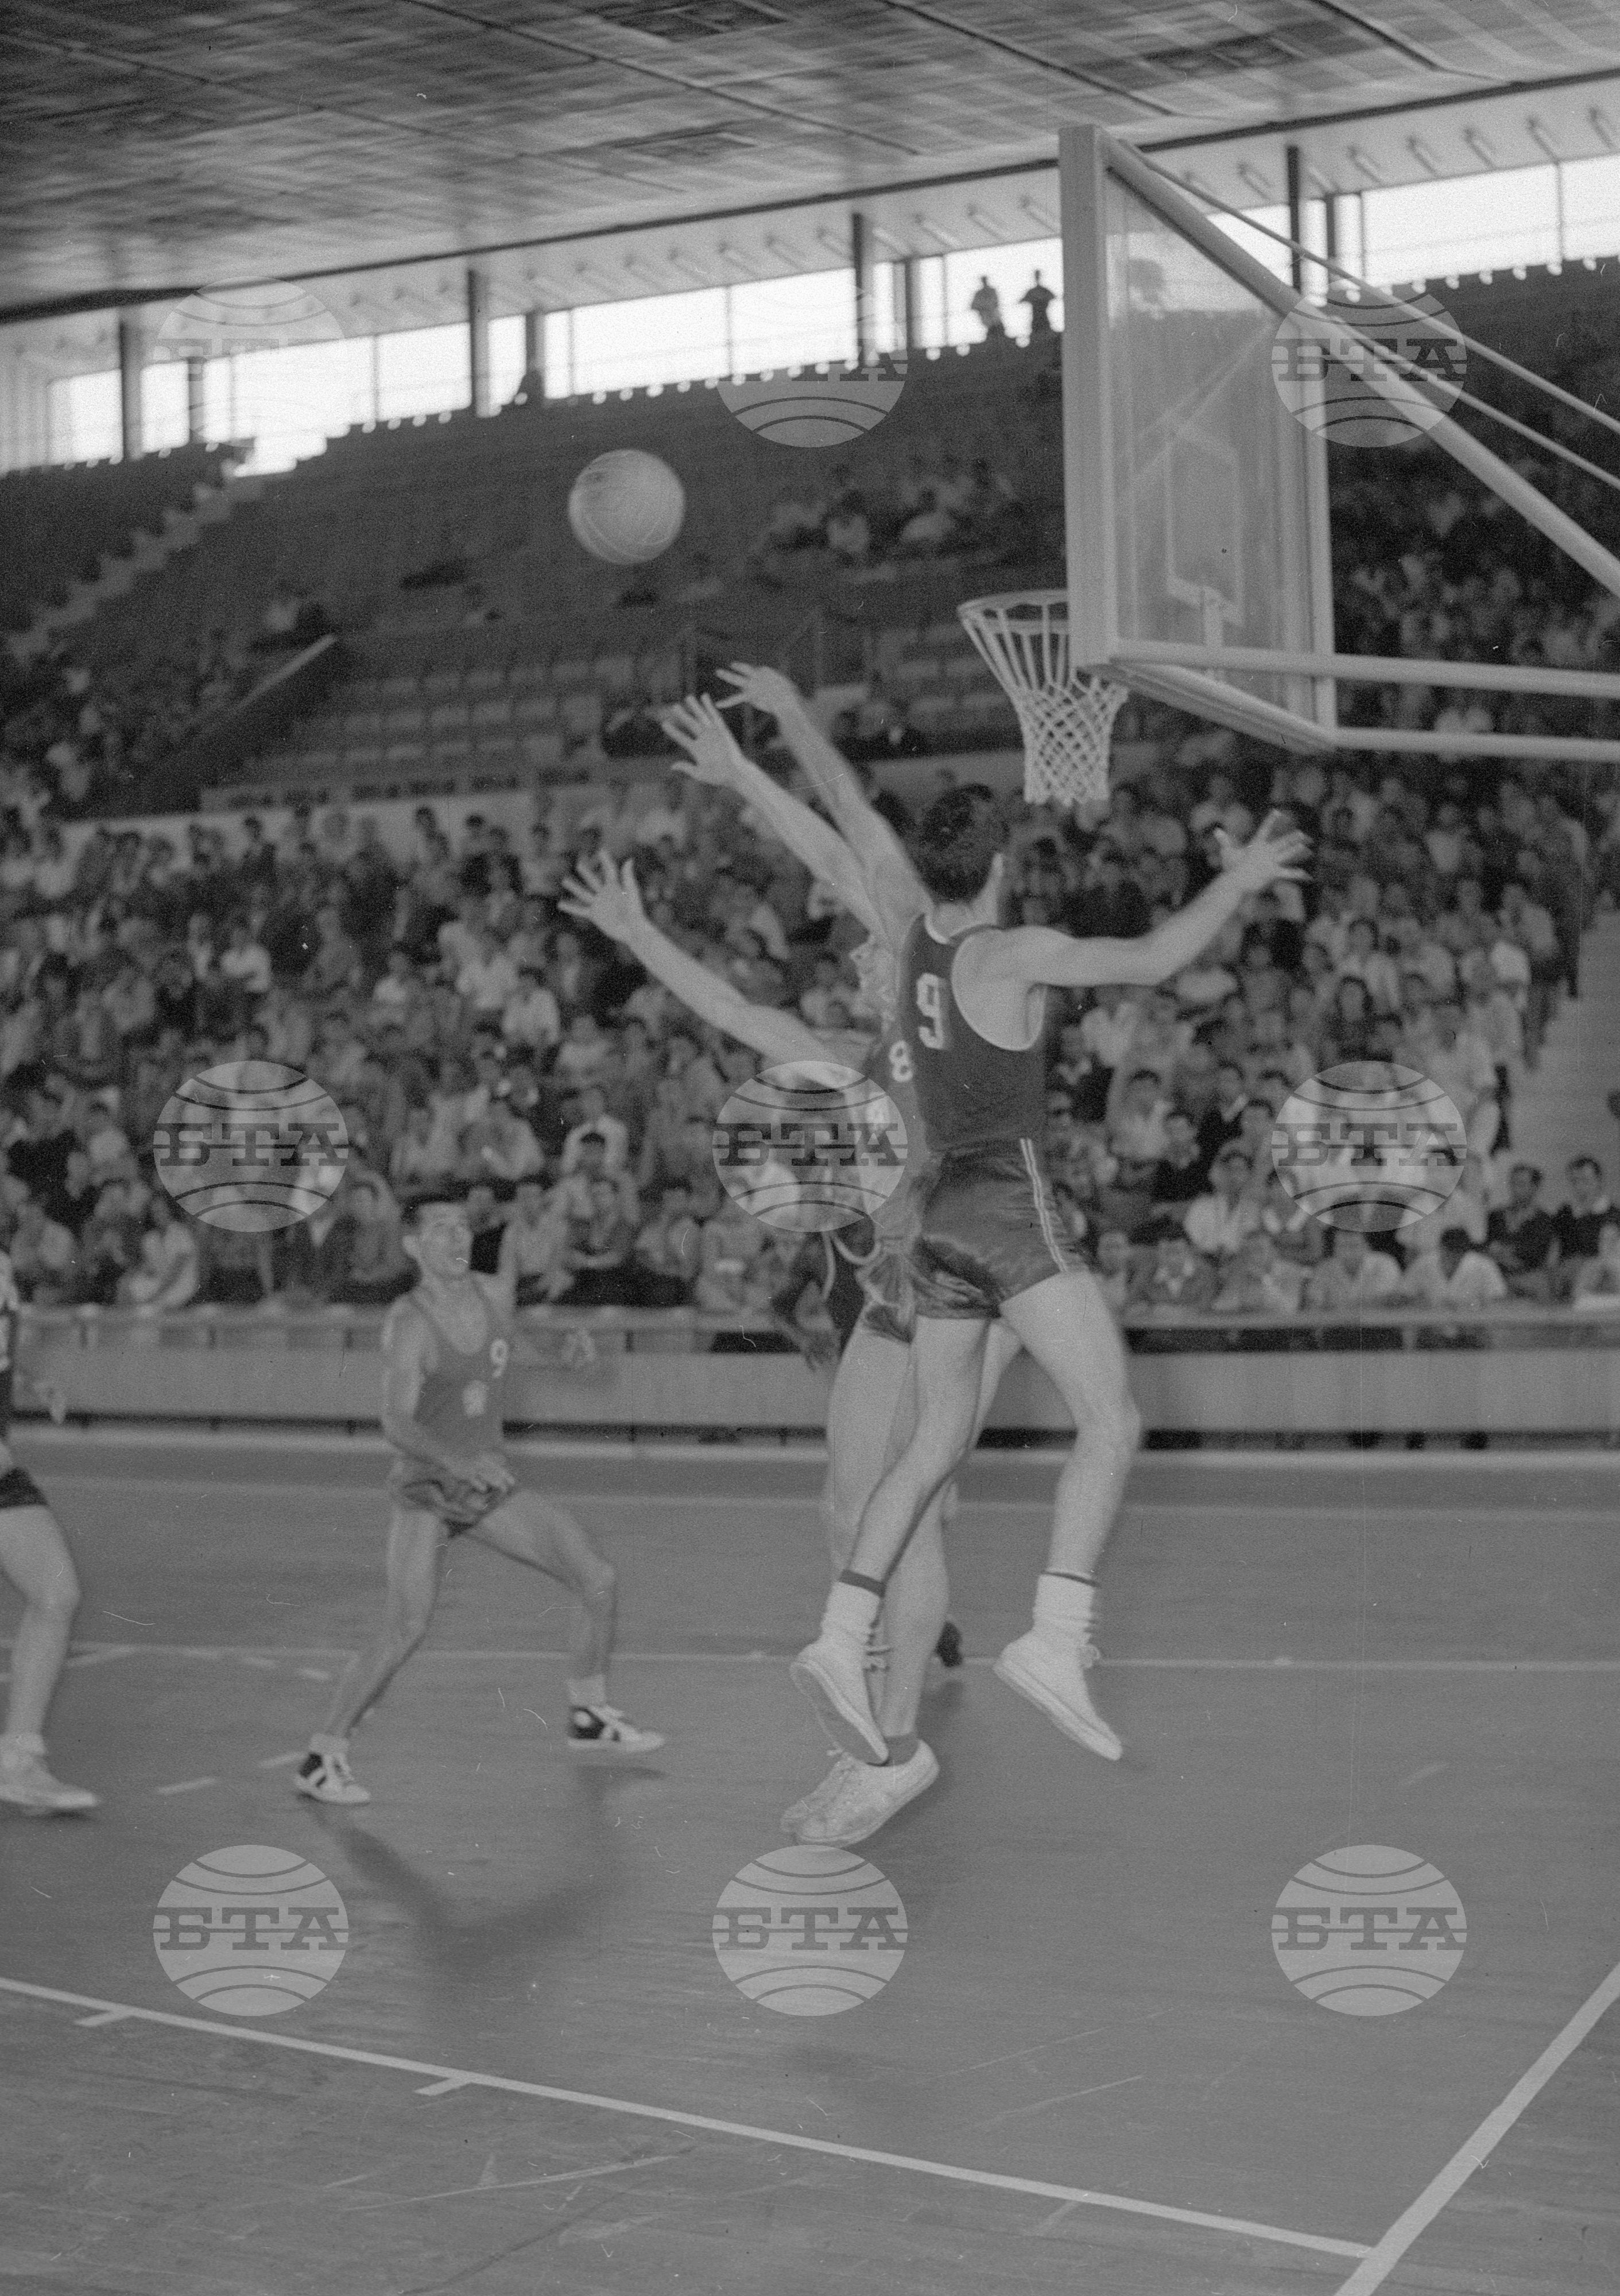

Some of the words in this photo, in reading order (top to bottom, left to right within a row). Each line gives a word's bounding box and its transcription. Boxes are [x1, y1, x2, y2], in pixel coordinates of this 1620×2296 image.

[917, 973, 944, 1049] 9
[889, 1040, 913, 1082] 8
[490, 1339, 508, 1378] 9
